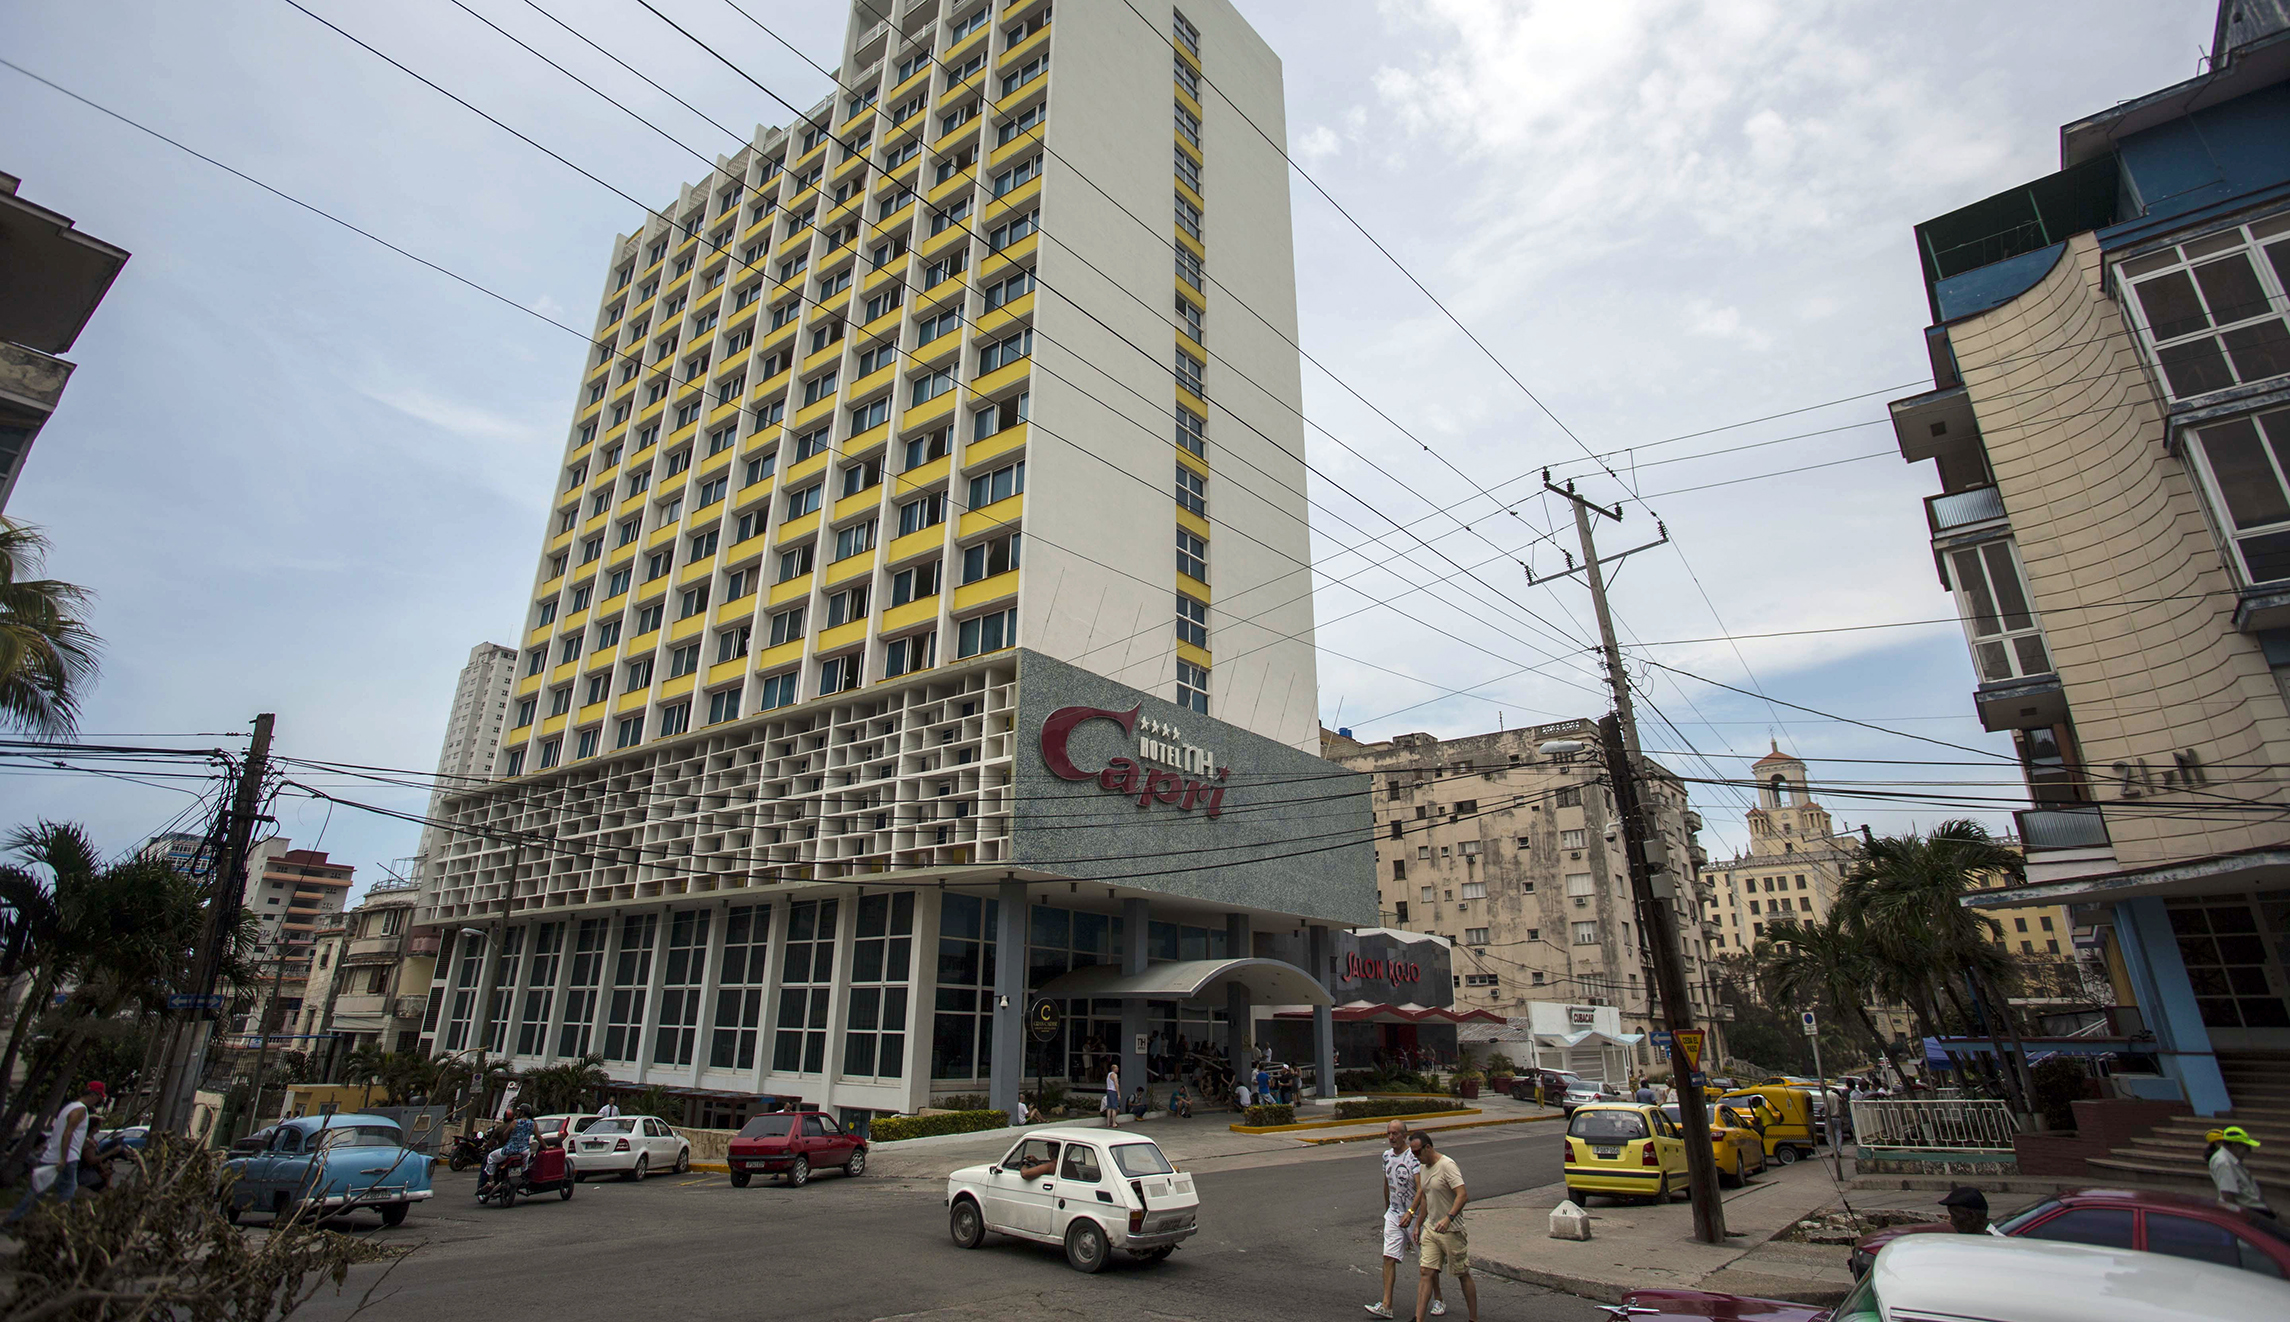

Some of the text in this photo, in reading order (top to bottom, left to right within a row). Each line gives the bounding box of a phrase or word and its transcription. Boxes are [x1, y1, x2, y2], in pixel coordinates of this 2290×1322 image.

[1040, 700, 1230, 819] Capri
[1139, 736, 1182, 768] HOTEL
[2111, 757, 2155, 798] 21
[2172, 748, 2207, 786] N
[1343, 951, 1421, 988] SALON ROJO
[1574, 1013, 1594, 1023] CUBACAR
[1682, 1036, 1700, 1045] CEDA EL
[1686, 1044, 1698, 1053] PASO
